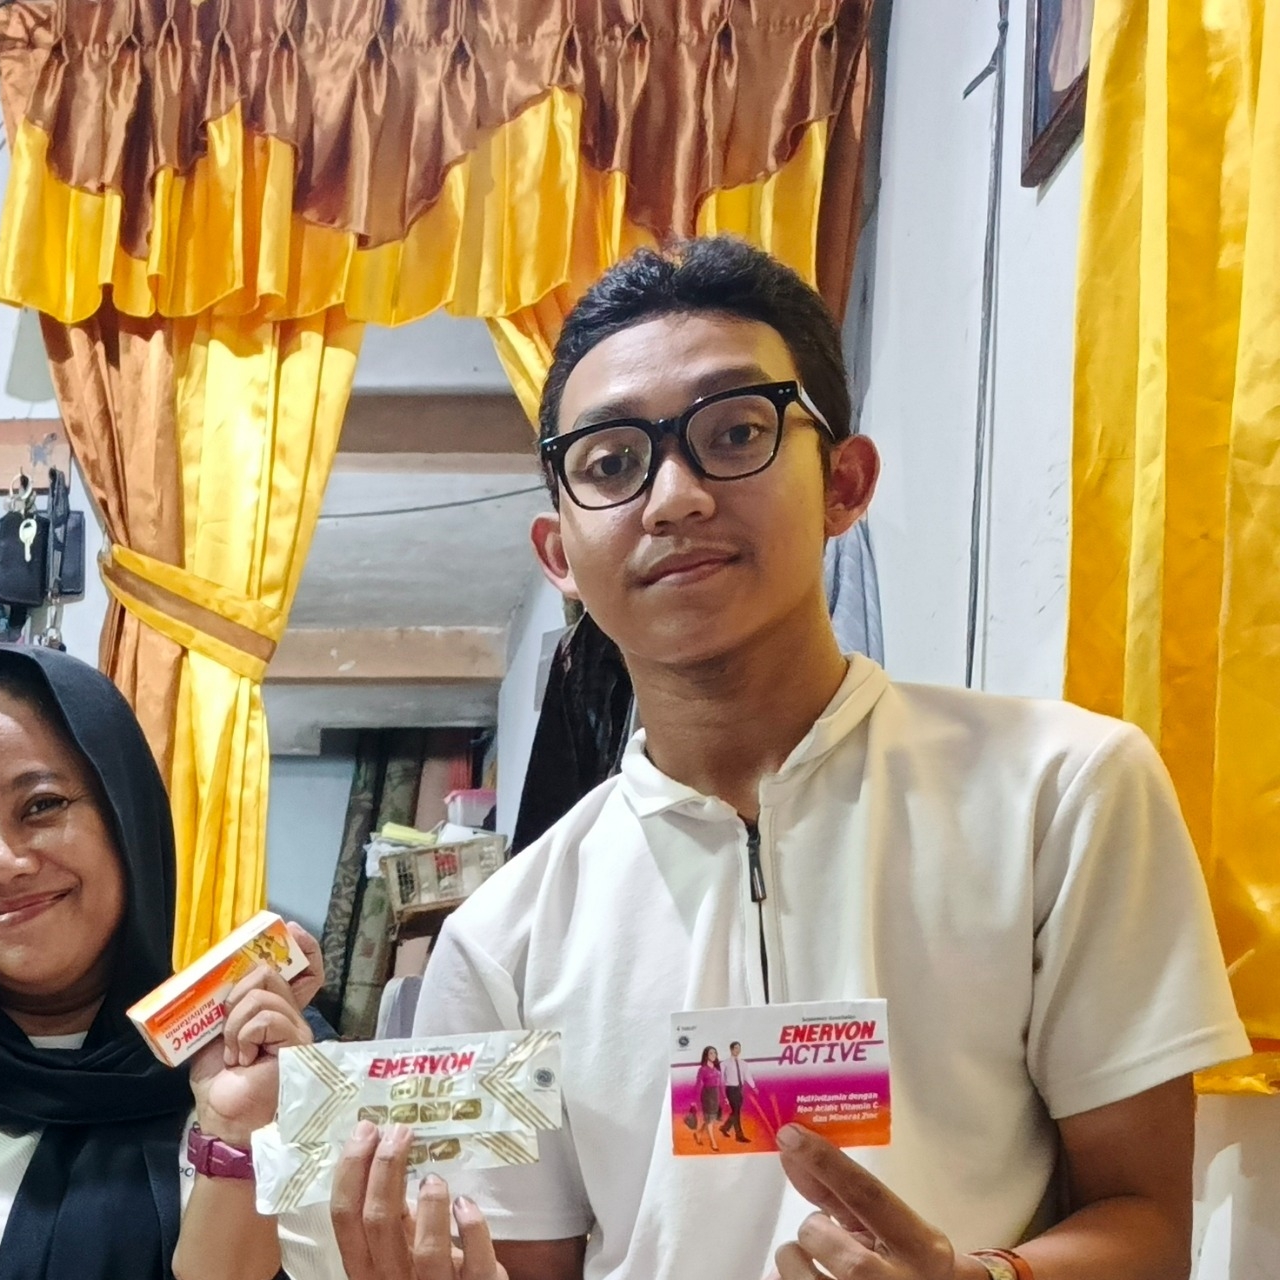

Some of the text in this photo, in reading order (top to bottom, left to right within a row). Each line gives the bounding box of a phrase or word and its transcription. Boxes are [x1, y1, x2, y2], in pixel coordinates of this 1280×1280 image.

[165, 998, 215, 1040] Multivitamin
[779, 1020, 876, 1044] ENERVON
[369, 1052, 476, 1079] ENERVON
[778, 1041, 870, 1066] ACTIVE
[840, 1102, 871, 1111] Vitamin
[872, 1101, 879, 1109] C
[848, 1092, 878, 1101] dengan
[828, 1113, 861, 1121] Mineral
